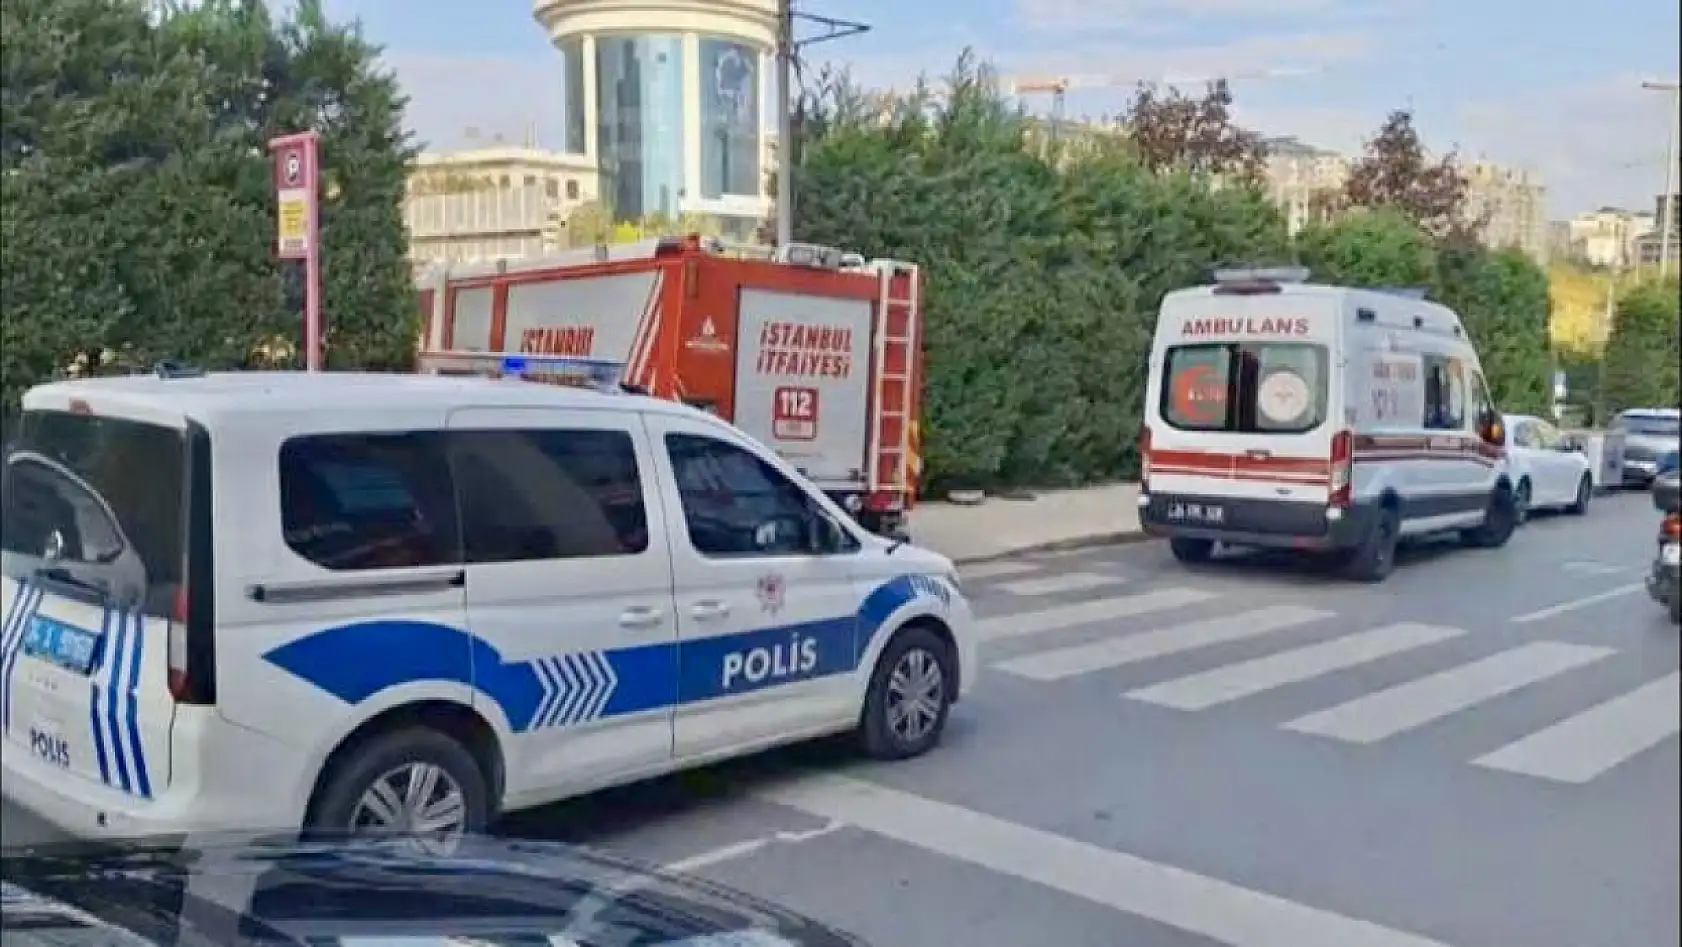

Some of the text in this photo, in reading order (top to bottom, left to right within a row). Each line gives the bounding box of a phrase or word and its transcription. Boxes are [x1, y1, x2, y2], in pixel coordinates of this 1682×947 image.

[760, 320, 852, 352] İSTANBUL
[1182, 318, 1309, 335] AMBULANS
[757, 350, 850, 379] İTFAİYESİ
[781, 390, 813, 417] 112
[722, 632, 817, 688] POLİS
